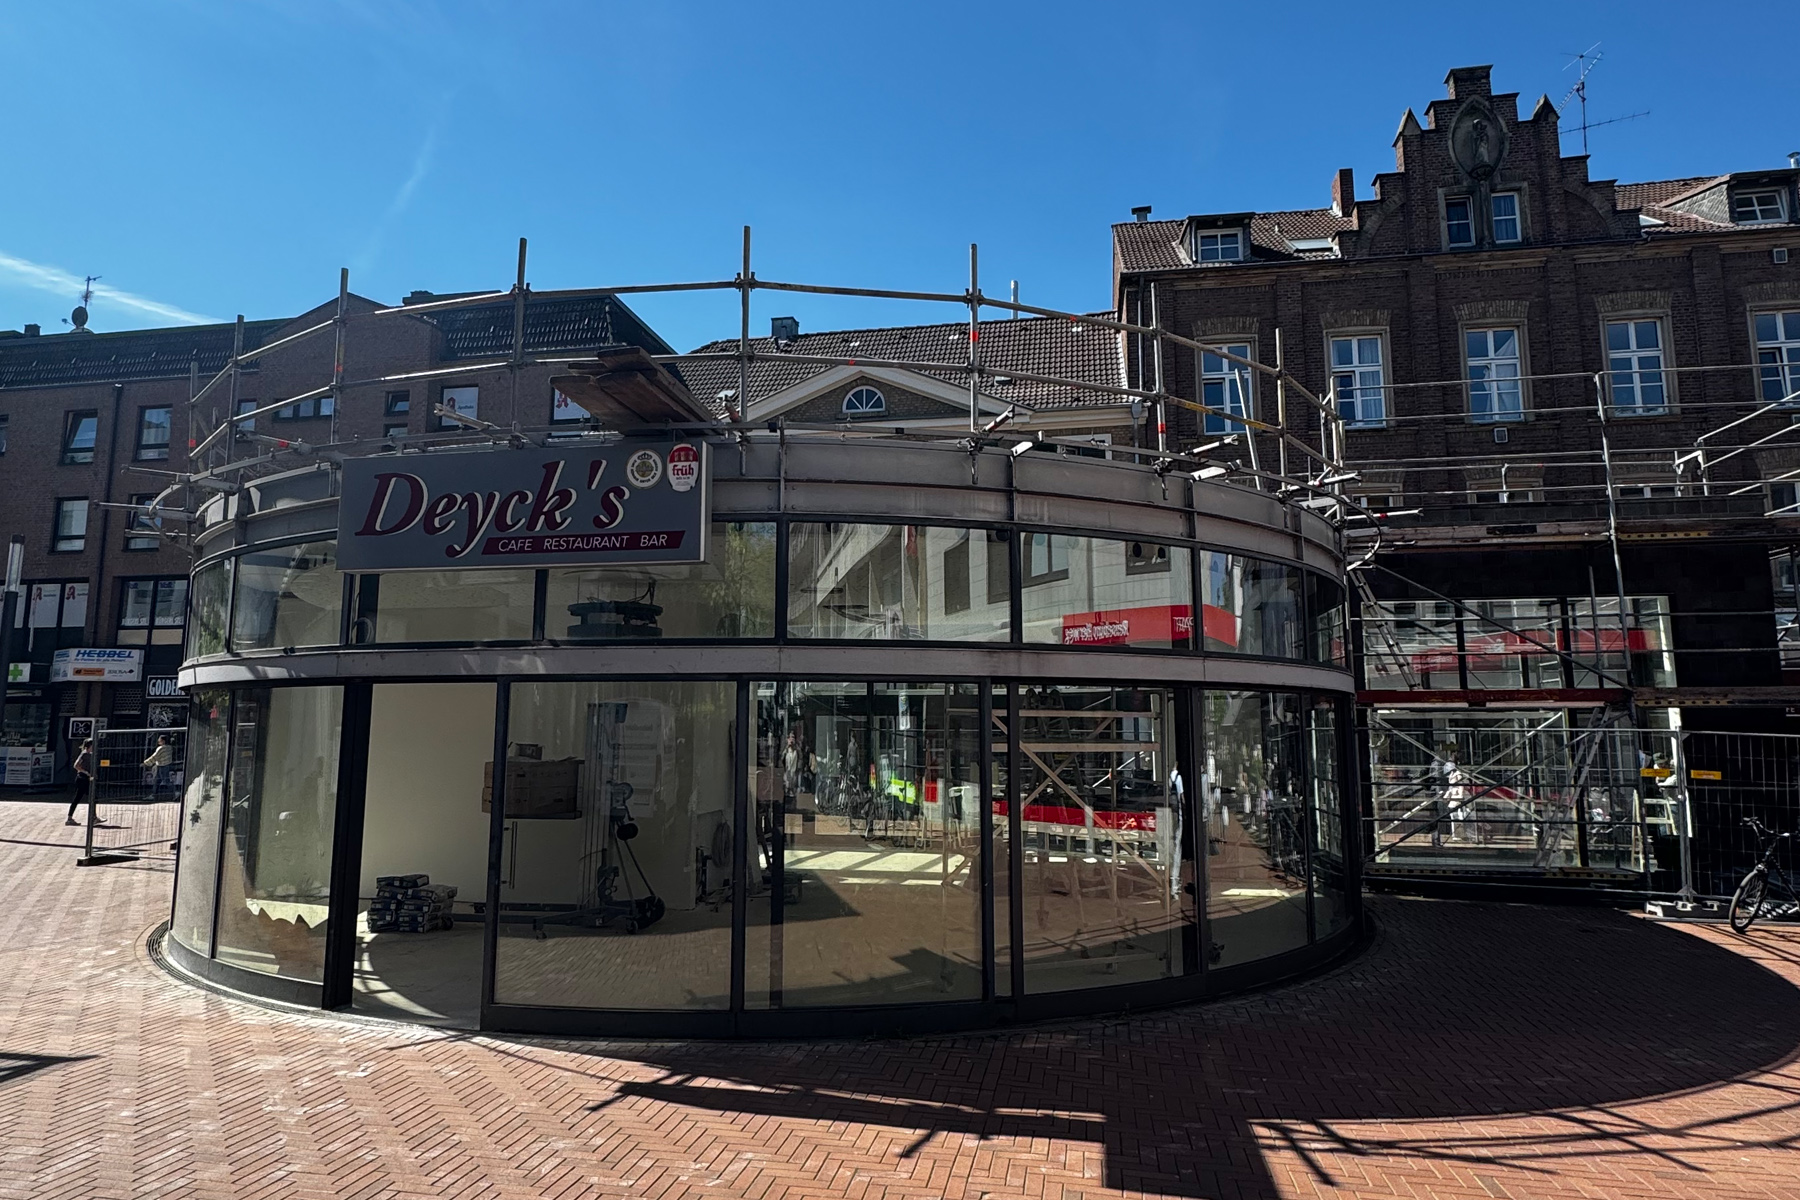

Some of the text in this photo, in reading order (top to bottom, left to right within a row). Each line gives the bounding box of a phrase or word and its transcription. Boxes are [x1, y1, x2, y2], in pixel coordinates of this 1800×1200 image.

[672, 463, 694, 477] früh
[354, 459, 631, 559] Deyck's
[498, 534, 668, 552] CAFE RESTAURANT BAR
[75, 649, 134, 659] HEBBEL
